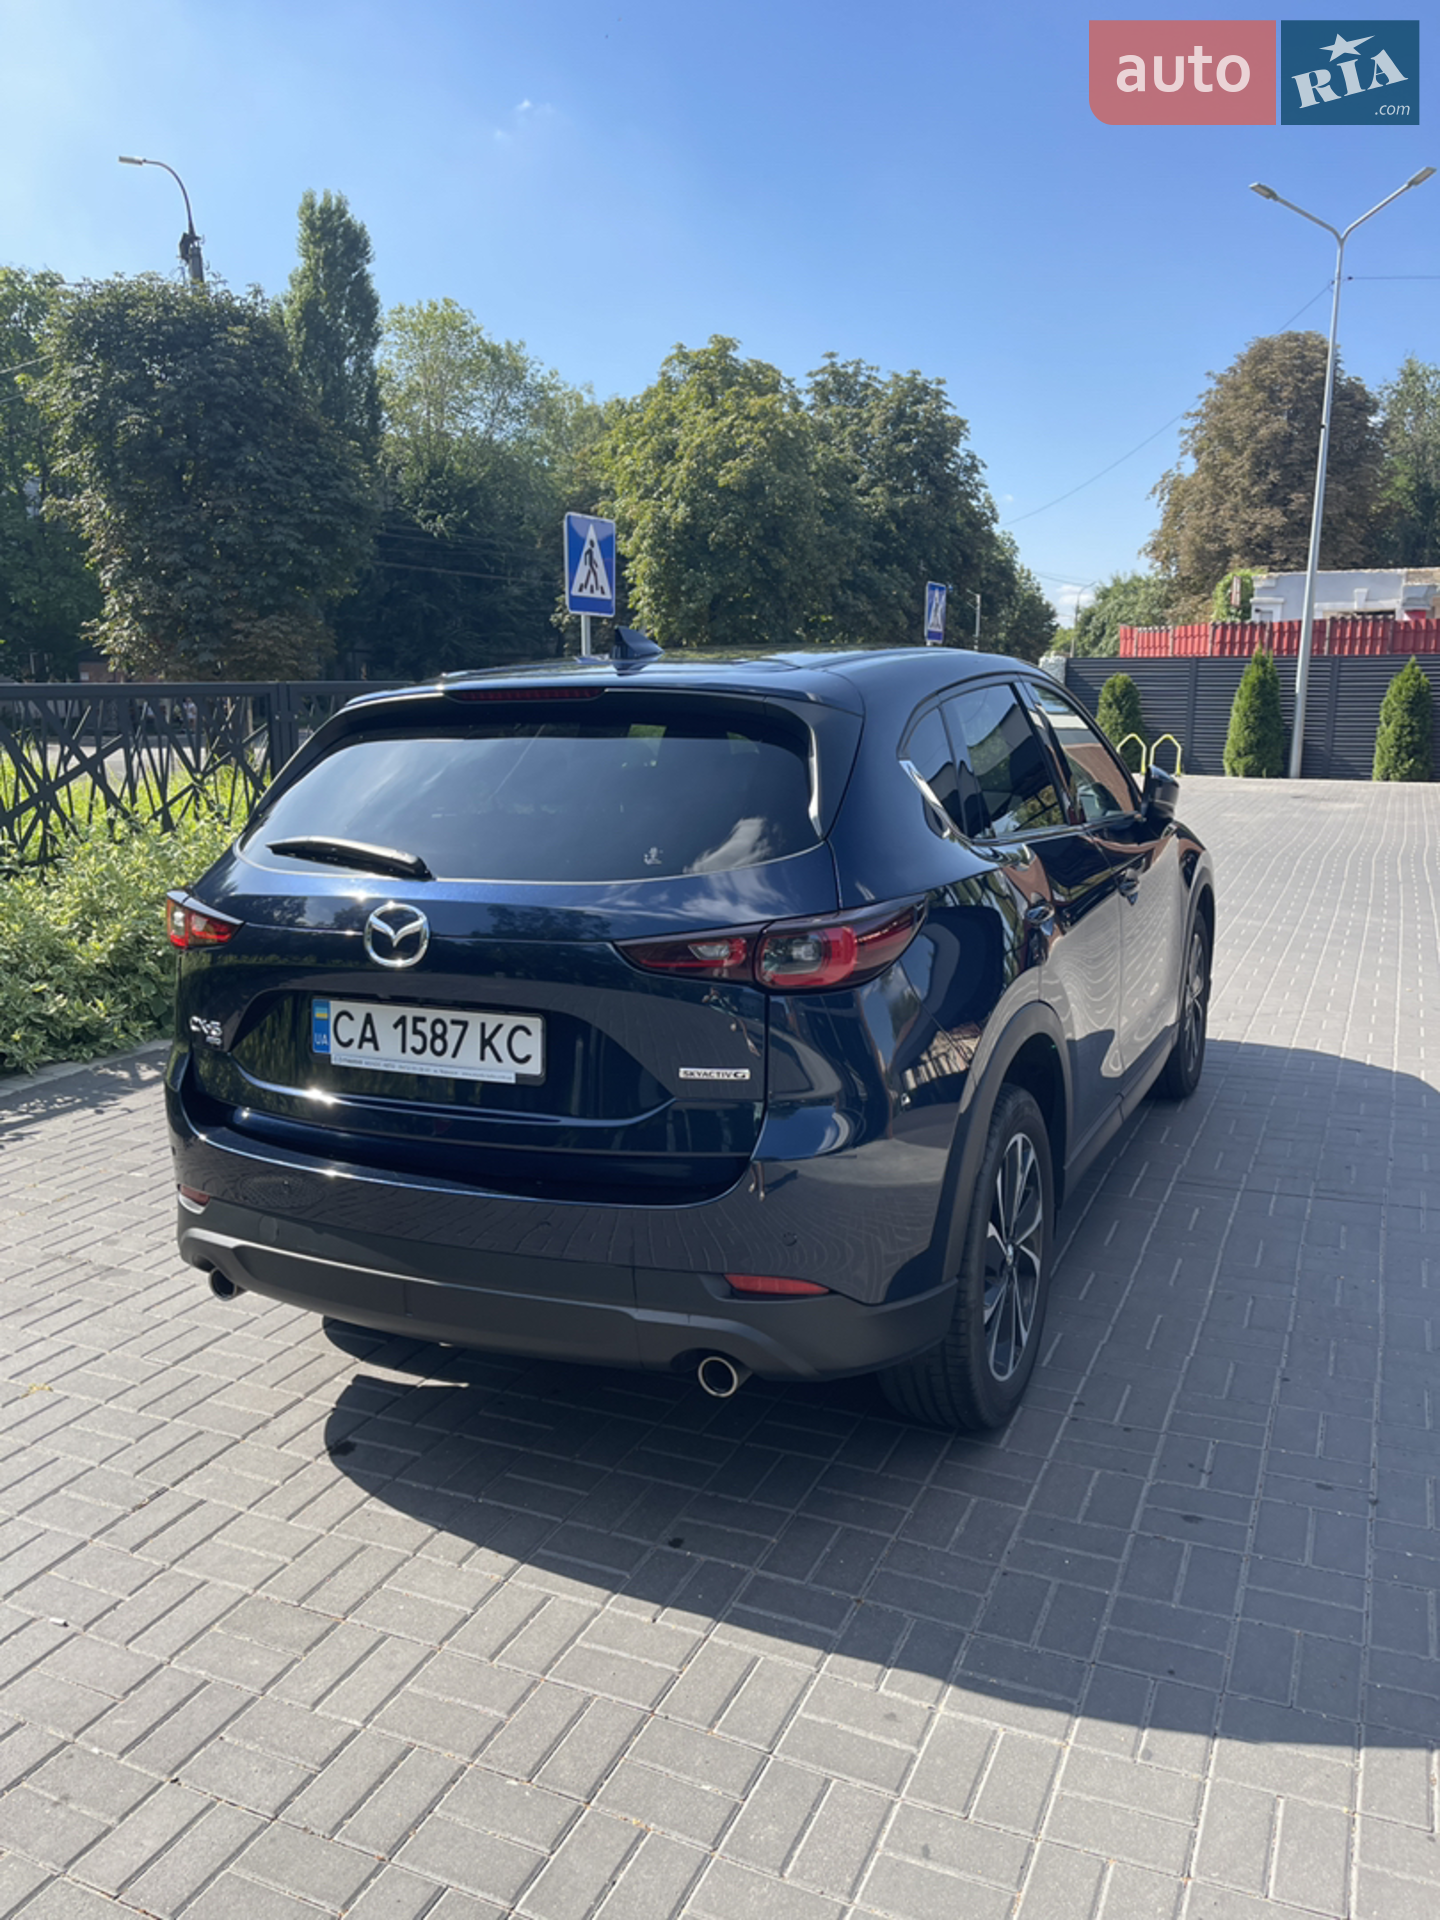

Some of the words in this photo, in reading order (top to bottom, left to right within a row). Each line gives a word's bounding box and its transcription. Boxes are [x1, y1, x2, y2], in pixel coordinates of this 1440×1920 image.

[315, 1033, 329, 1046] UA
[333, 1010, 380, 1052] CA
[392, 1014, 469, 1059] 1587
[479, 1021, 533, 1065] KC
